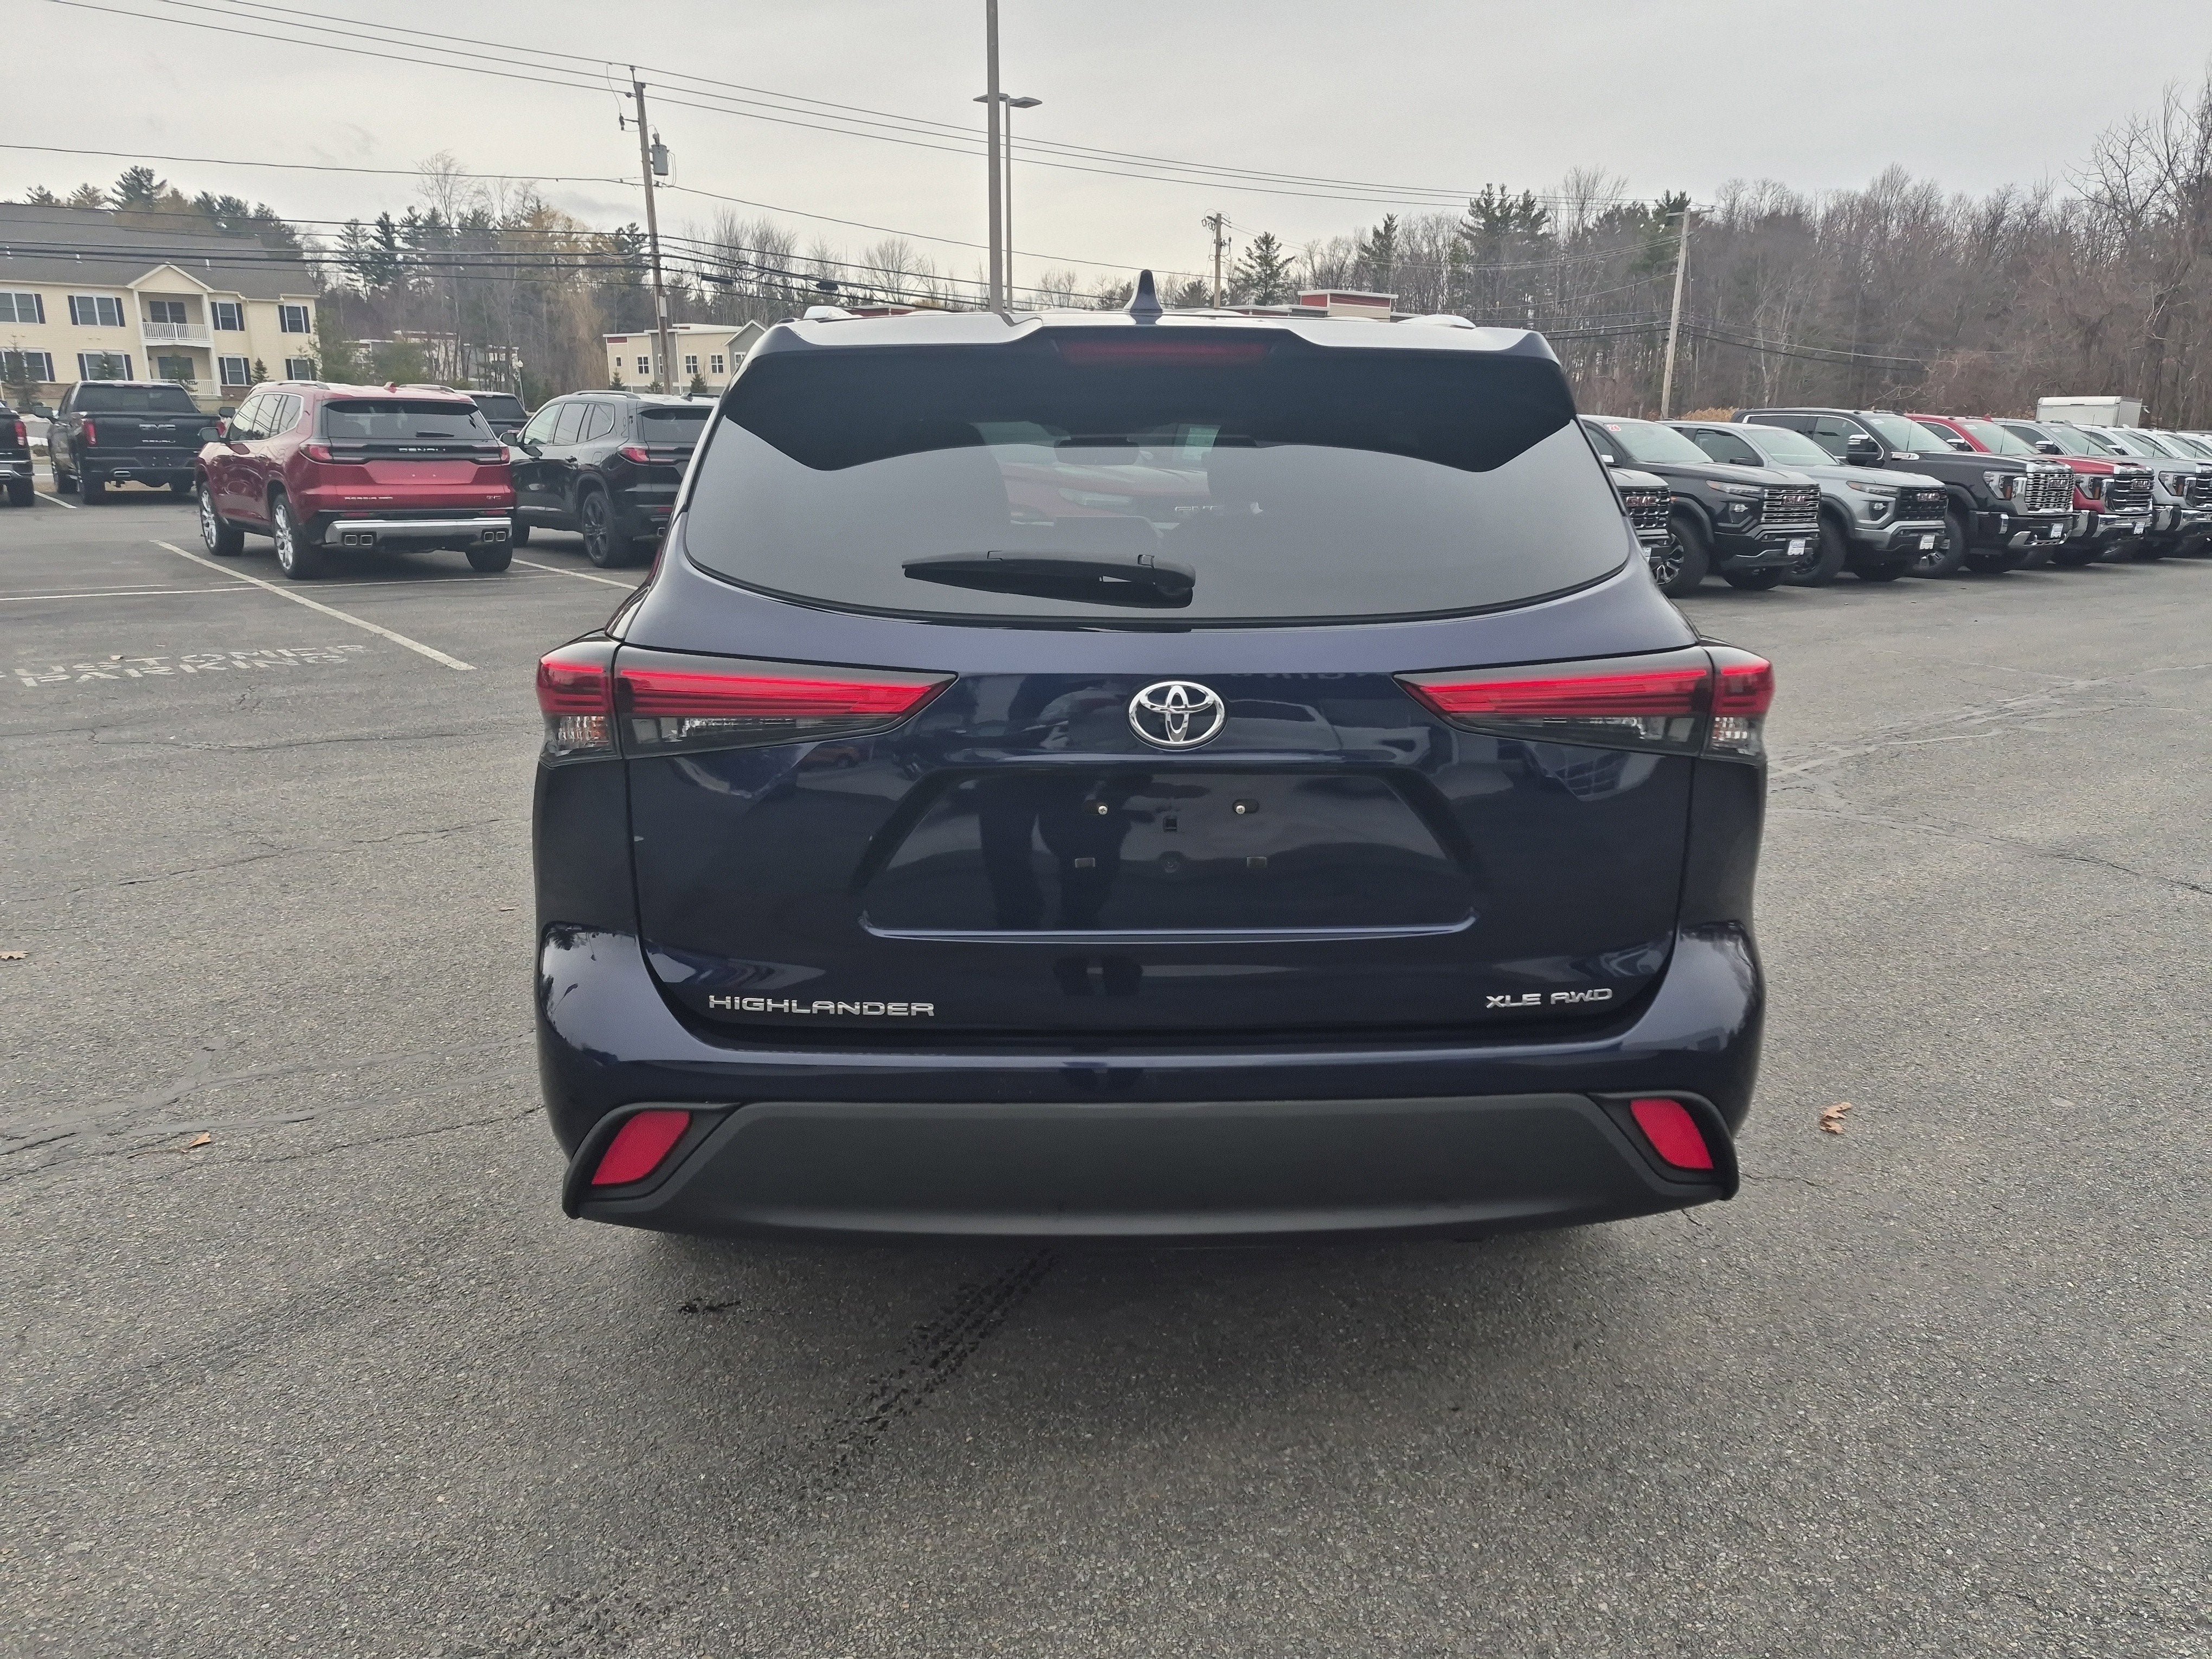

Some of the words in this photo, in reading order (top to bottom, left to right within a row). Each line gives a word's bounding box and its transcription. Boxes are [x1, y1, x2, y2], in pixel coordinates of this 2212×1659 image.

[1626, 496, 1658, 507] GMC
[709, 995, 935, 1017] HIGHLANDER
[1486, 993, 1542, 1009] XLE
[1550, 988, 1613, 1005] AWD
